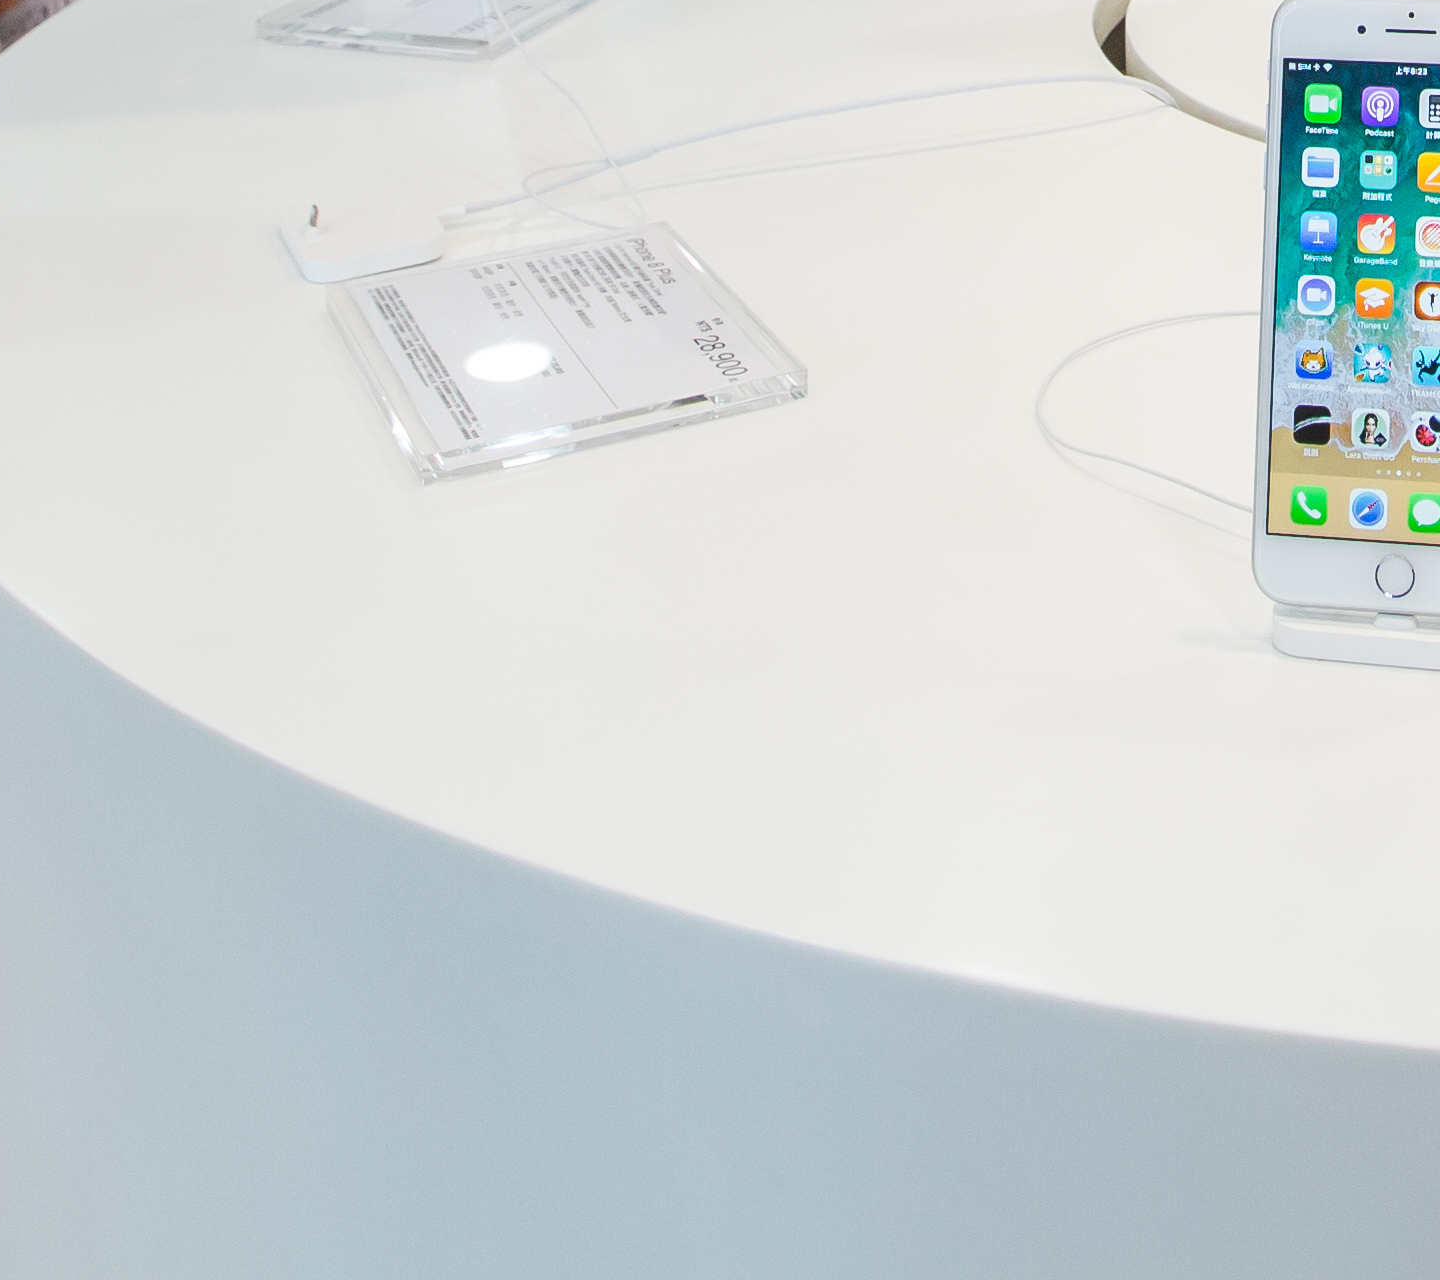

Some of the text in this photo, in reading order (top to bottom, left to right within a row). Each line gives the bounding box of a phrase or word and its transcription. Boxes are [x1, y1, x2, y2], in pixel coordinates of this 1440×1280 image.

[1305, 126, 1339, 135] FaceTime
[1365, 129, 1394, 138] Podcast
[1303, 254, 1332, 263] Keynote
[1354, 256, 1398, 266] GarageBand
[693, 334, 749, 377] 28,900
